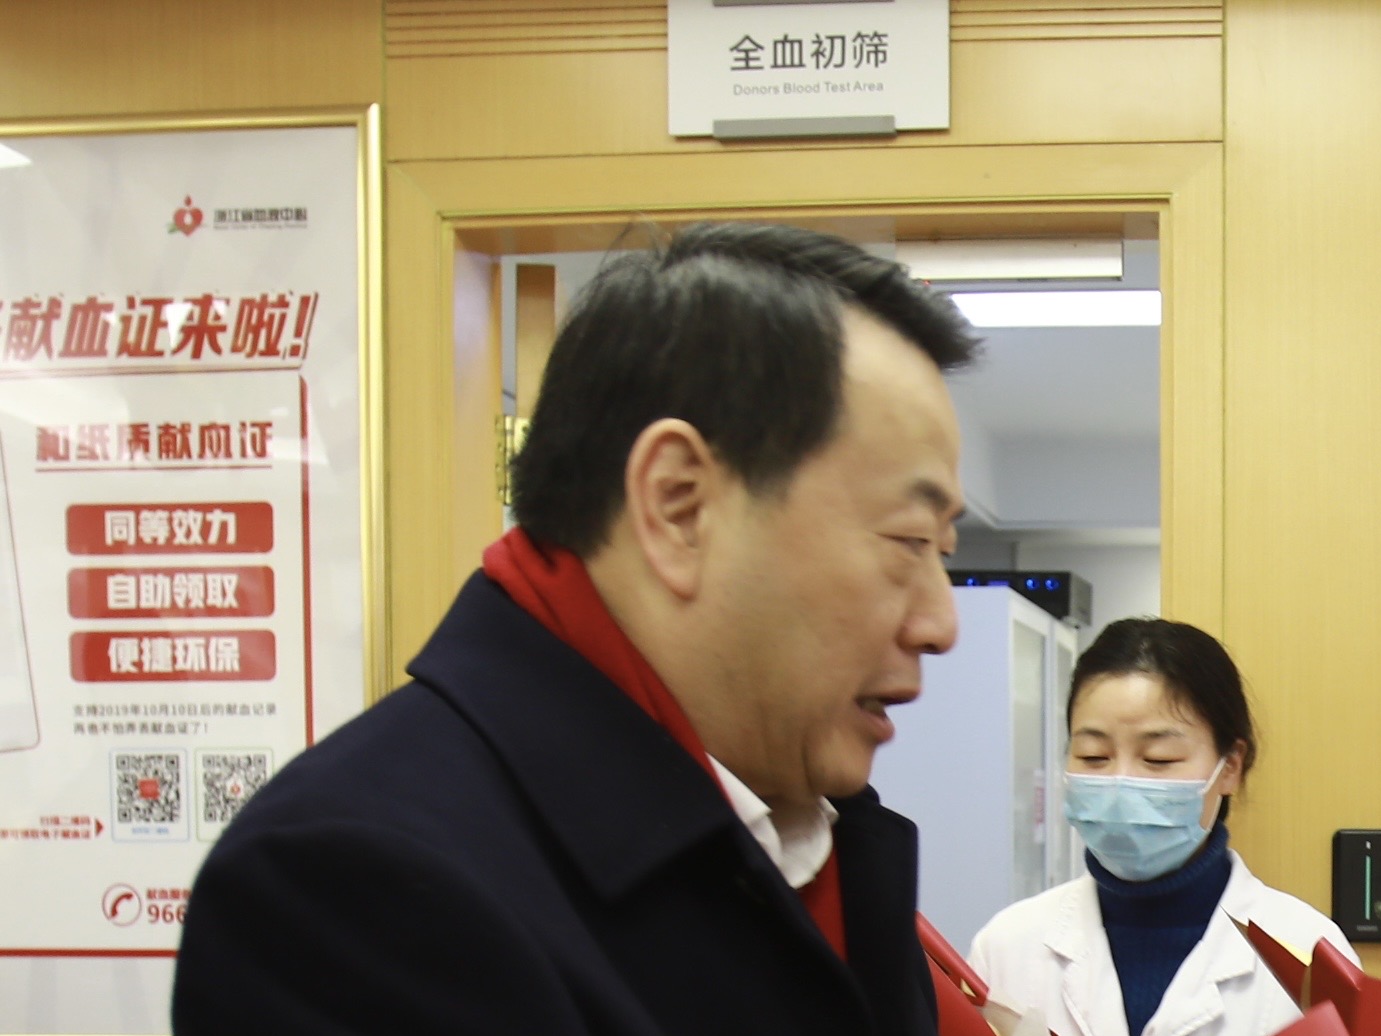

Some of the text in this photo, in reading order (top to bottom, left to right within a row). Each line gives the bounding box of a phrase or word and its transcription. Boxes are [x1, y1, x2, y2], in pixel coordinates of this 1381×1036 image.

[729, 31, 889, 71] 全血初筛
[733, 81, 884, 96] Donors Blood Test Area
[104, 510, 237, 545] 同等效力
[106, 574, 239, 609] 自助领取
[108, 637, 240, 673] 便捷环保
